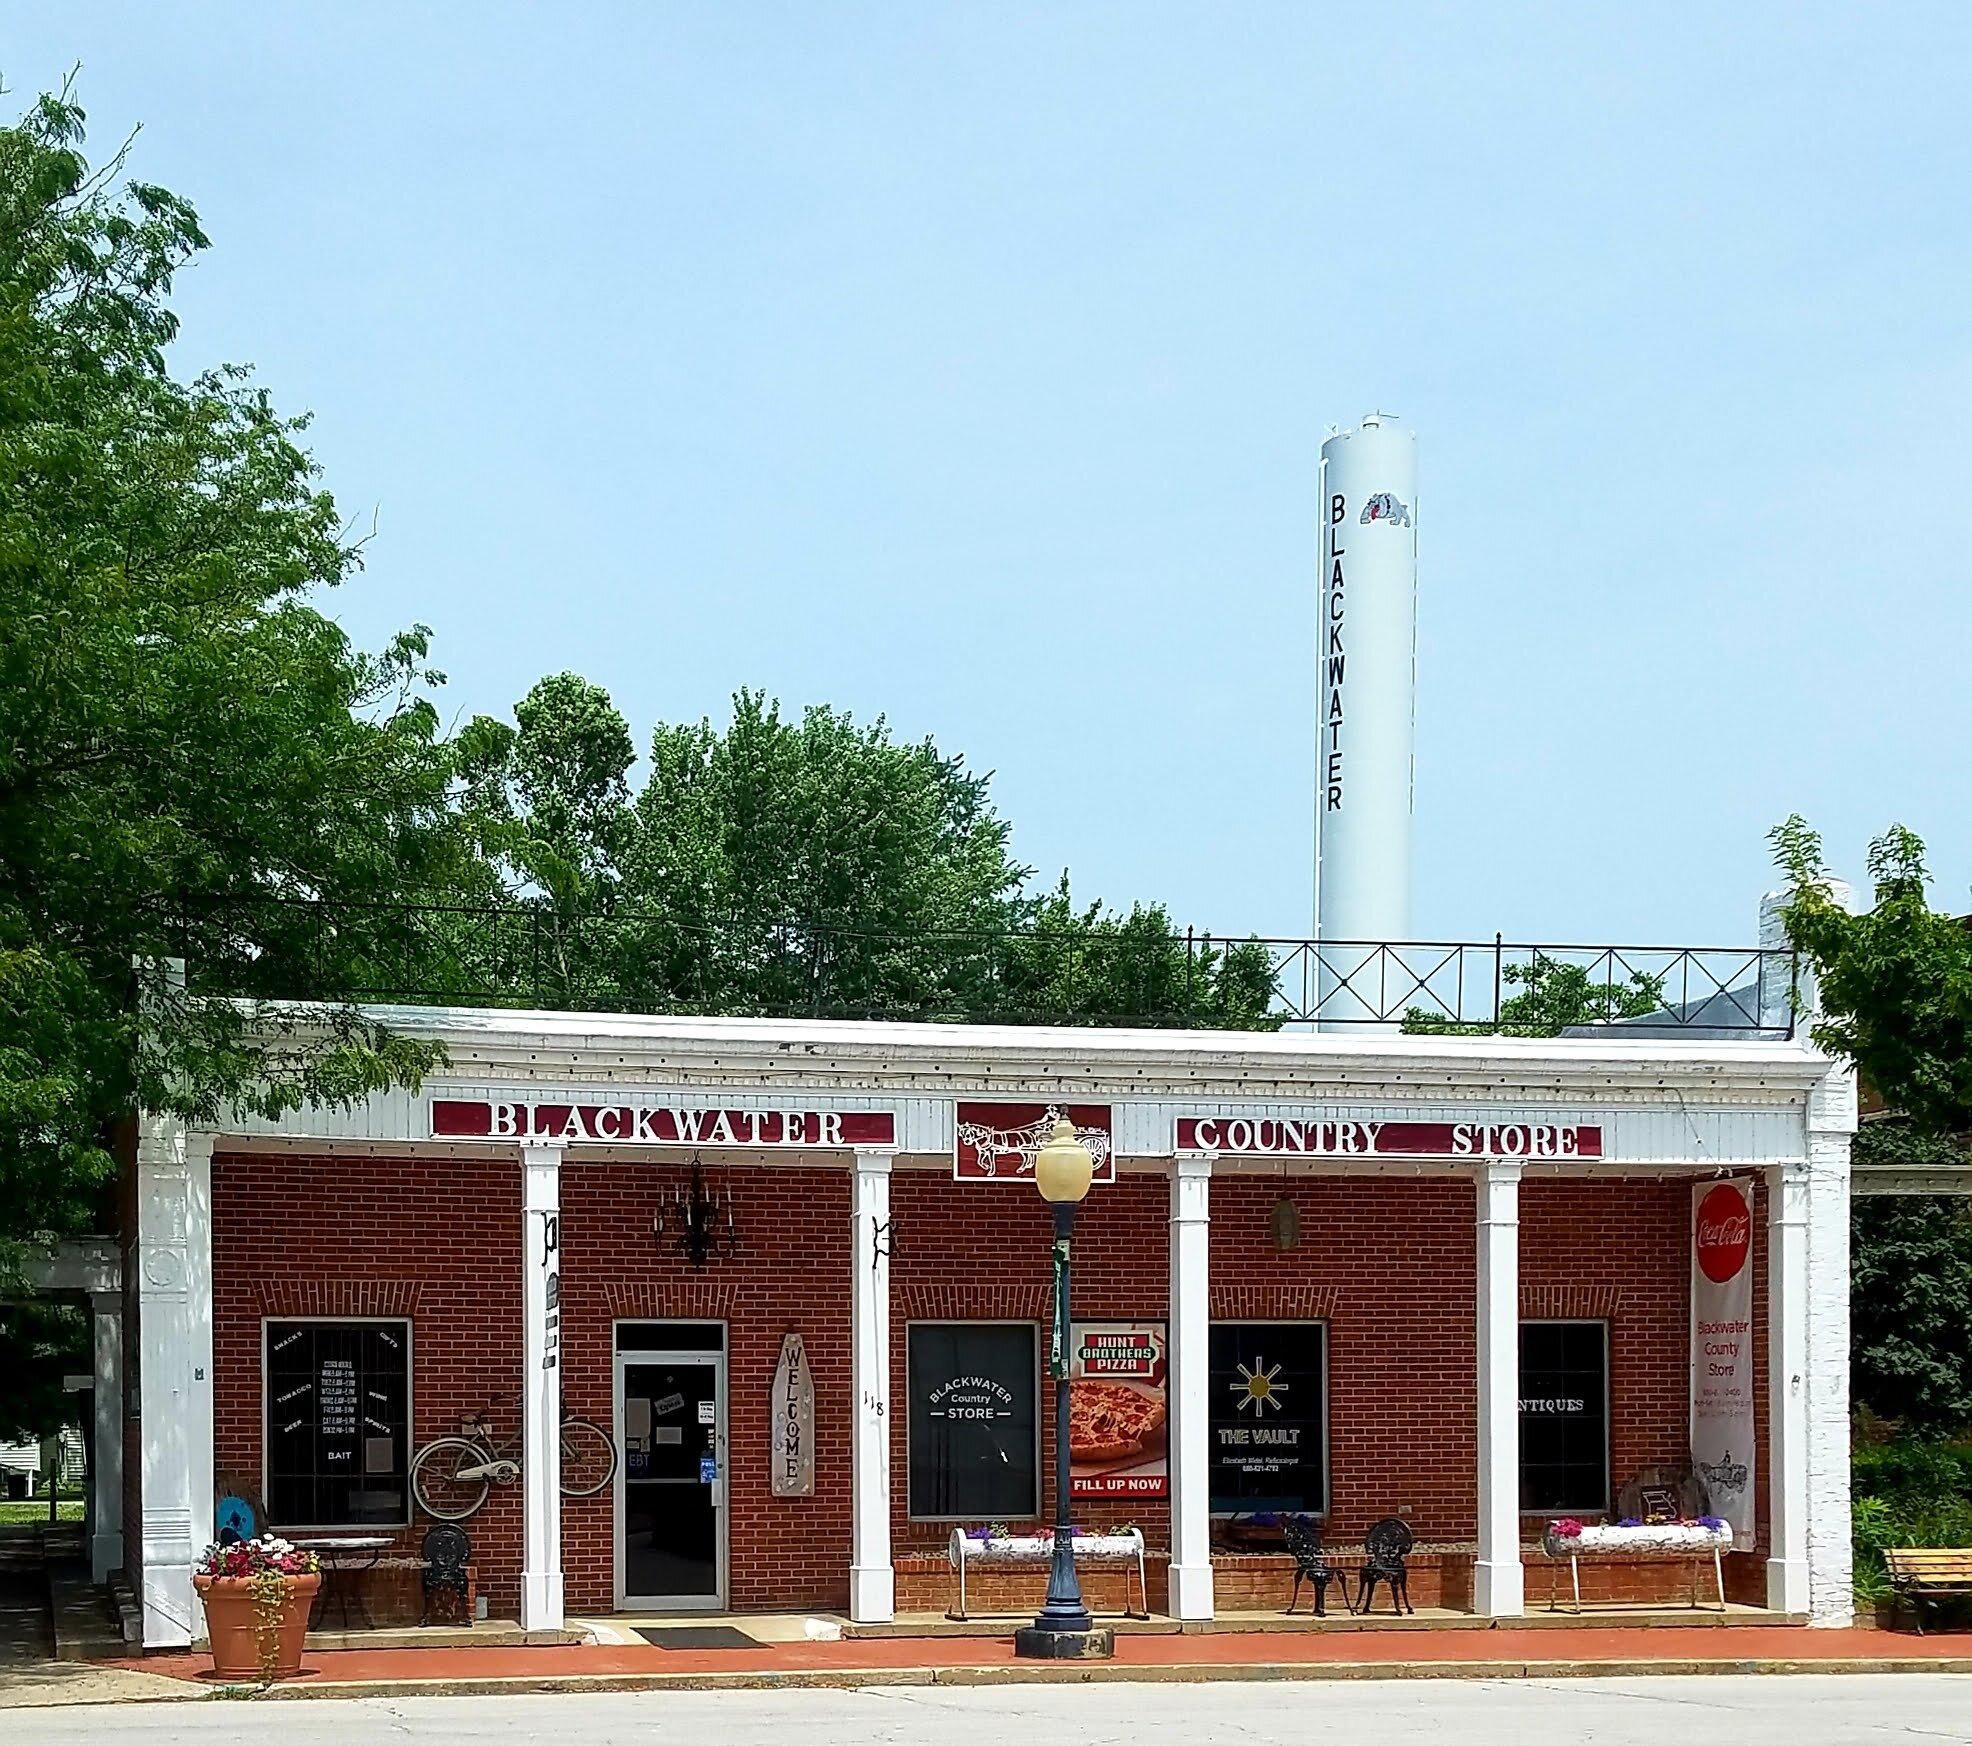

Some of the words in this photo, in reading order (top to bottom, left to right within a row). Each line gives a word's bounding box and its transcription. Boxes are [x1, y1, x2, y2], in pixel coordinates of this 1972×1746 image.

[1327, 494, 1346, 812] BLACKWATER
[487, 1101, 846, 1145] BLACKWATER
[1194, 1118, 1385, 1153] COUNTRY
[1452, 1122, 1579, 1157] STORE
[273, 1331, 303, 1351] SNACKS
[1097, 1336, 1137, 1348] HUNT
[1082, 1348, 1152, 1359] BROTHERS
[1097, 1359, 1137, 1370] PIZZA
[1708, 1363, 1735, 1376] Store
[276, 1384, 312, 1403] TOBACCO
[929, 1376, 1012, 1404] BLACKWATER
[864, 1390, 884, 1417] 118
[951, 1394, 991, 1404] Country
[1518, 1399, 1584, 1413] NTIQUES
[785, 1347, 801, 1479] WELCOME
[948, 1408, 994, 1419] STORE
[1218, 1429, 1249, 1444] THE
[1252, 1429, 1300, 1444] VAULT
[328, 1452, 352, 1460] BAIT
[629, 1454, 650, 1467] EBT
[1074, 1480, 1104, 1490] FILL
[1107, 1480, 1126, 1490] UP
[1128, 1479, 1162, 1490] NOW
